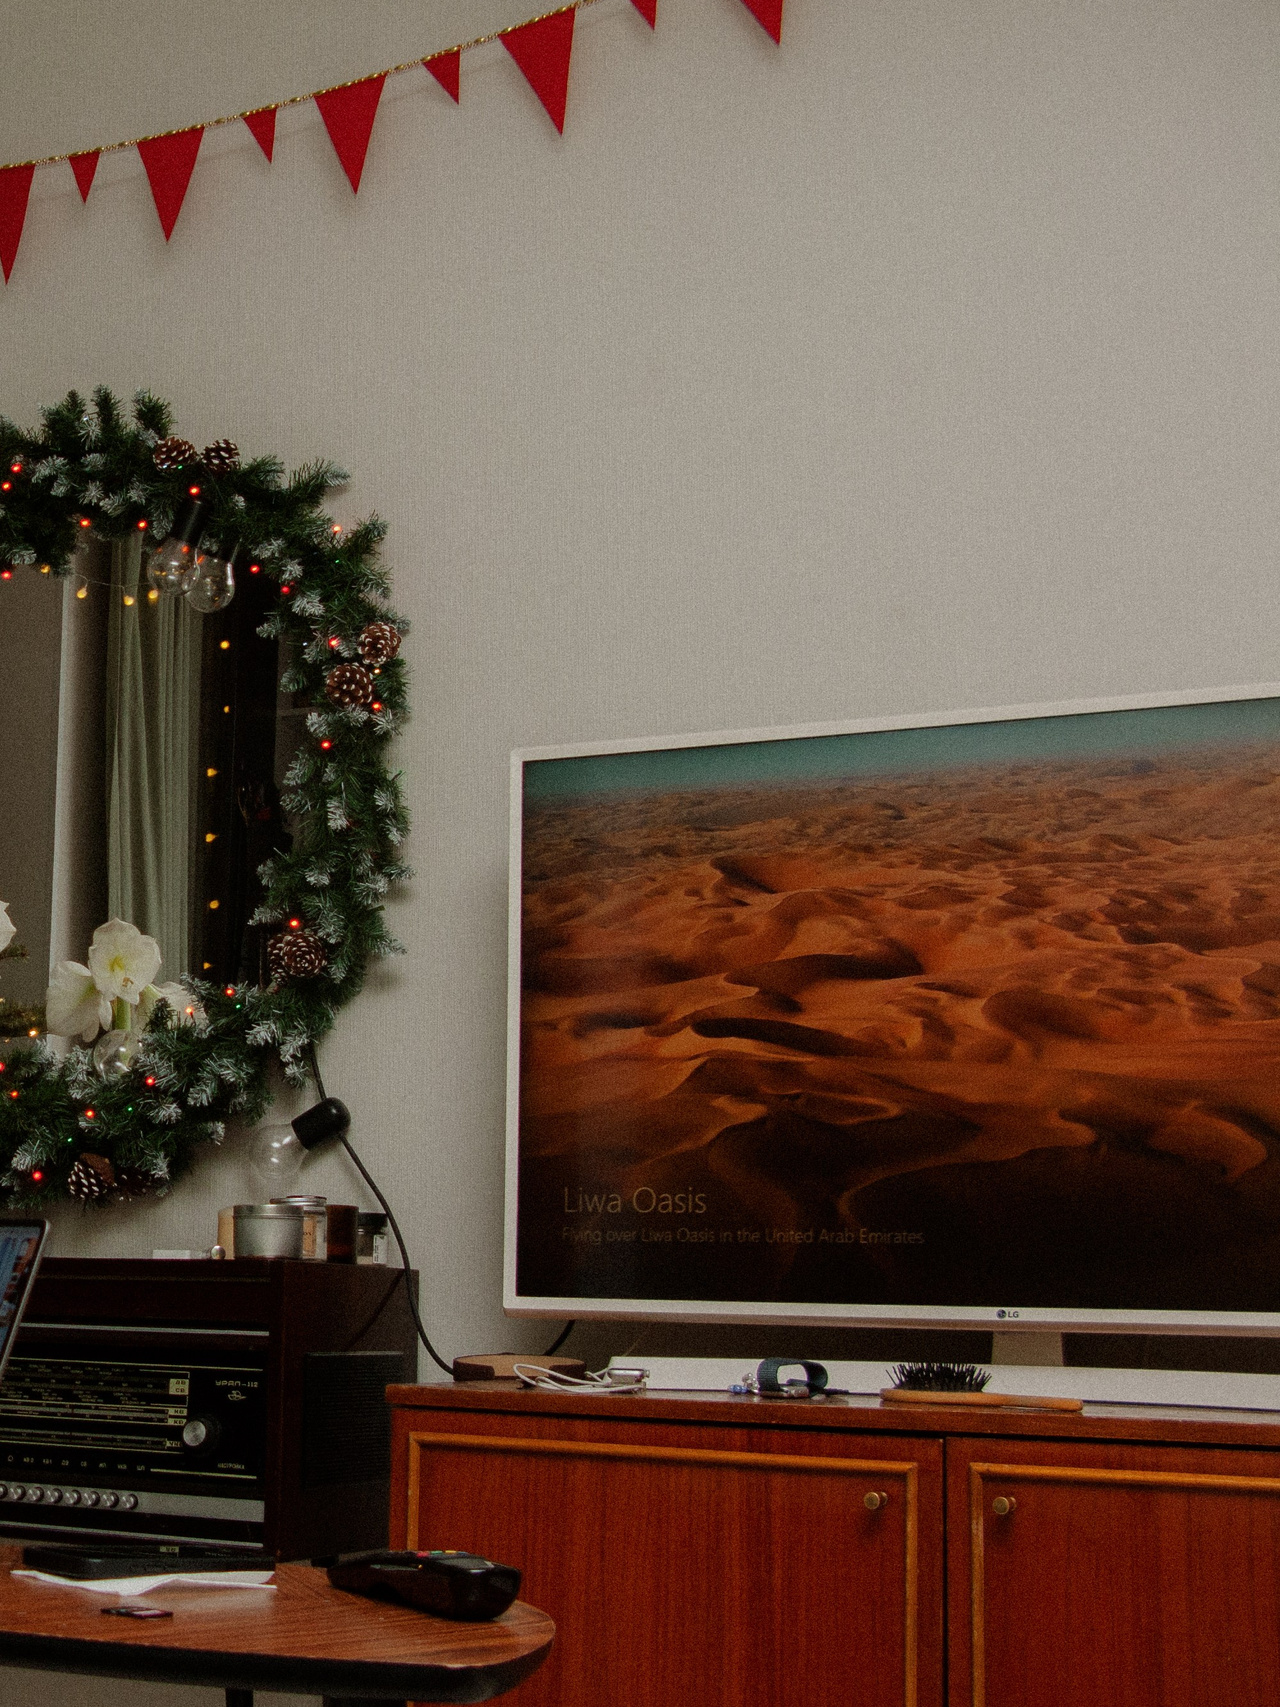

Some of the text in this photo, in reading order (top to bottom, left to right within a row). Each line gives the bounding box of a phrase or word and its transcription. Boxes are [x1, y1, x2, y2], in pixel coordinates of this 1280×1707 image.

[564, 1186, 708, 1214] Liwa Oasis
[562, 1227, 925, 1245] Flying over Liwa Oasis in the United Arab Emirates
